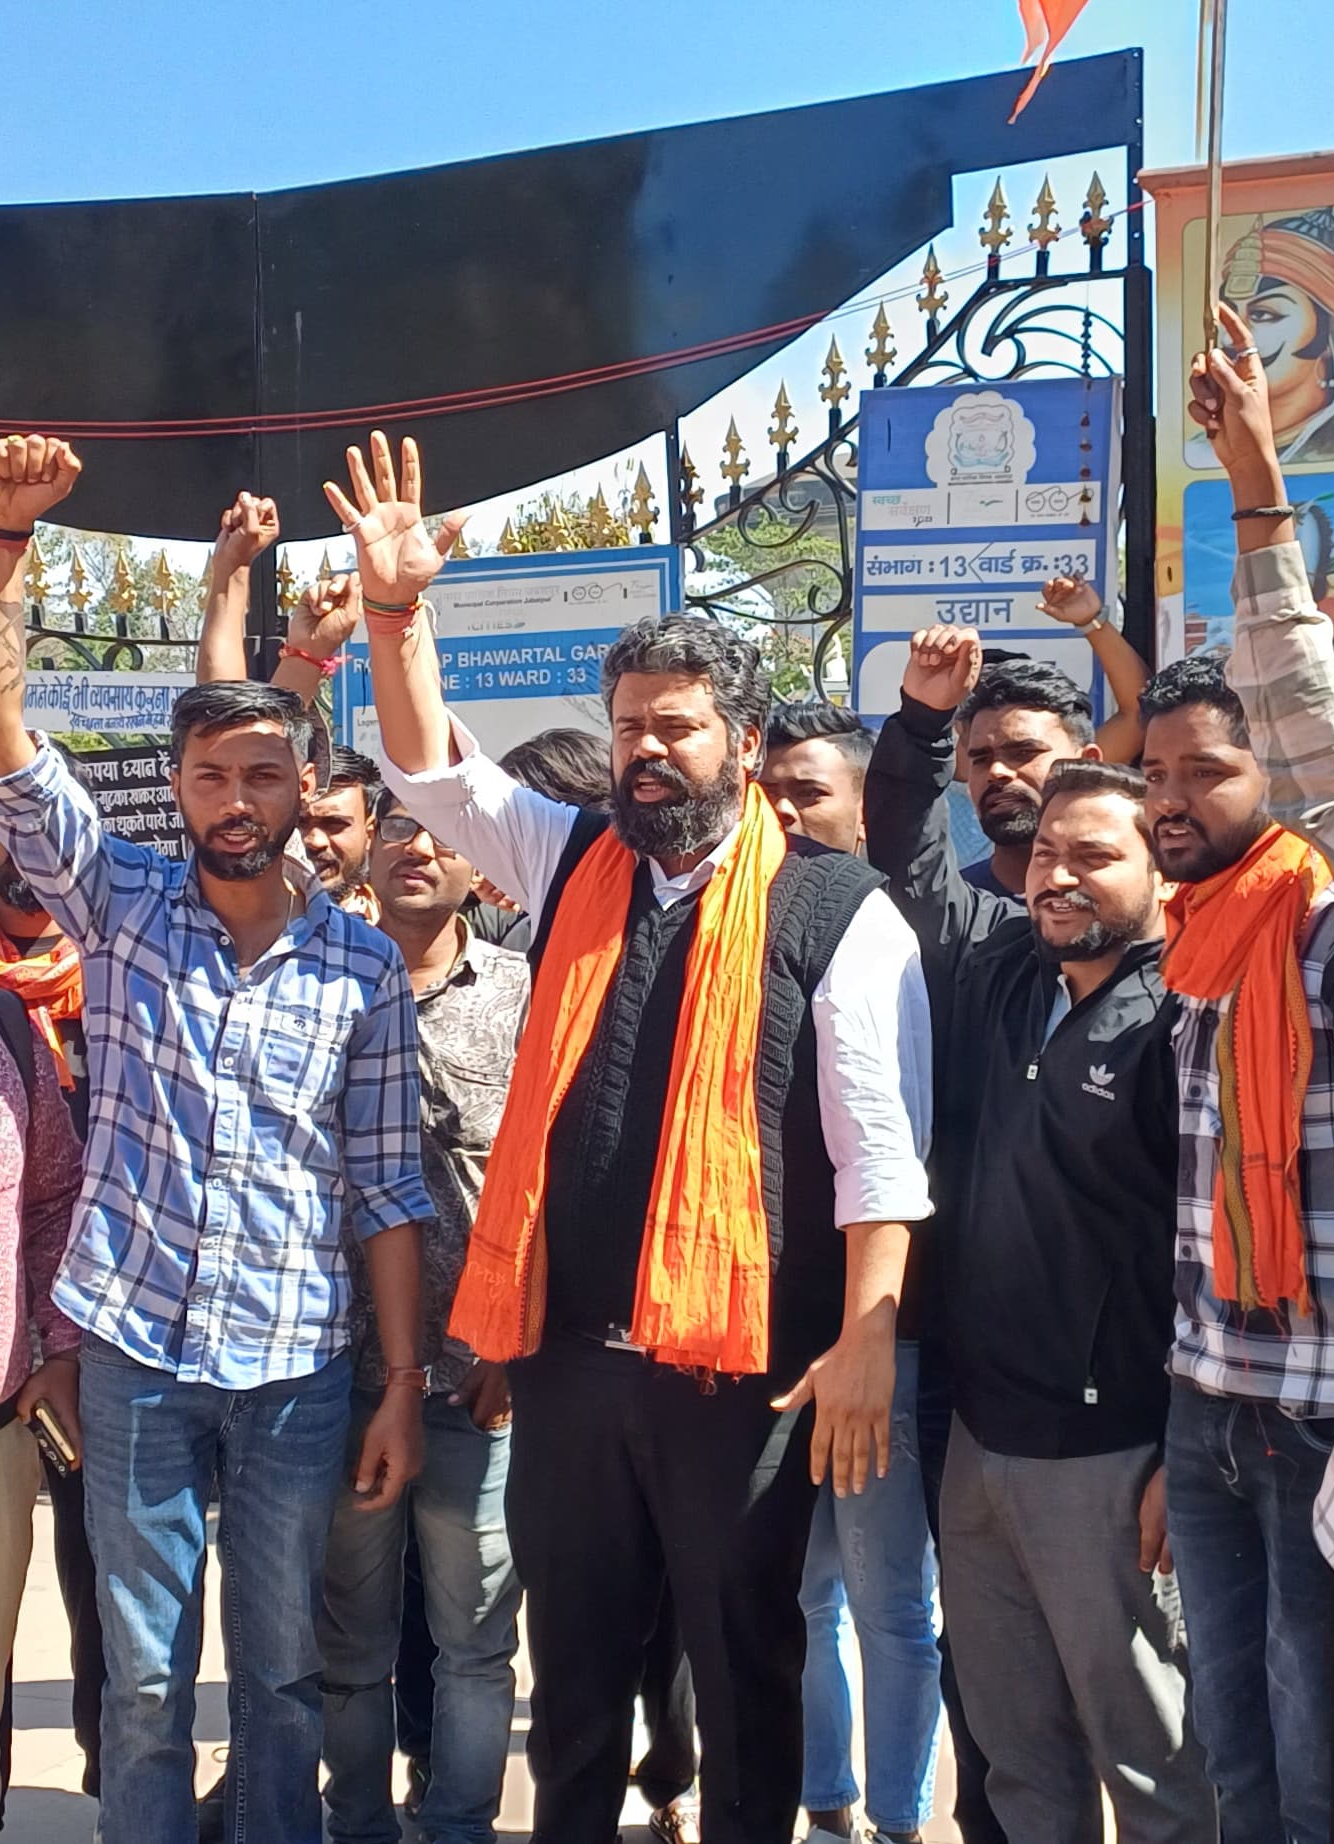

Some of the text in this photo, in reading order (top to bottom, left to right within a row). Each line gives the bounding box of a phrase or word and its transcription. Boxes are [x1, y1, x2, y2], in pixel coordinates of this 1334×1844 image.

[866, 555, 922, 576] संभाग
[939, 555, 967, 578] 13
[978, 549, 1017, 574] वार्ड
[936, 599, 1014, 625] उद्यान
[458, 646, 566, 668] BHAWARTAL
[570, 643, 614, 662] GAR
[475, 672, 494, 689] 13
[498, 668, 551, 688] WARD
[567, 667, 587, 684] 33
[48, 675, 73, 715] कोई
[72, 677, 90, 710] भी
[134, 686, 171, 711] करना
[122, 758, 158, 779] ध्यान
[1082, 1082, 1115, 1101] adidas
